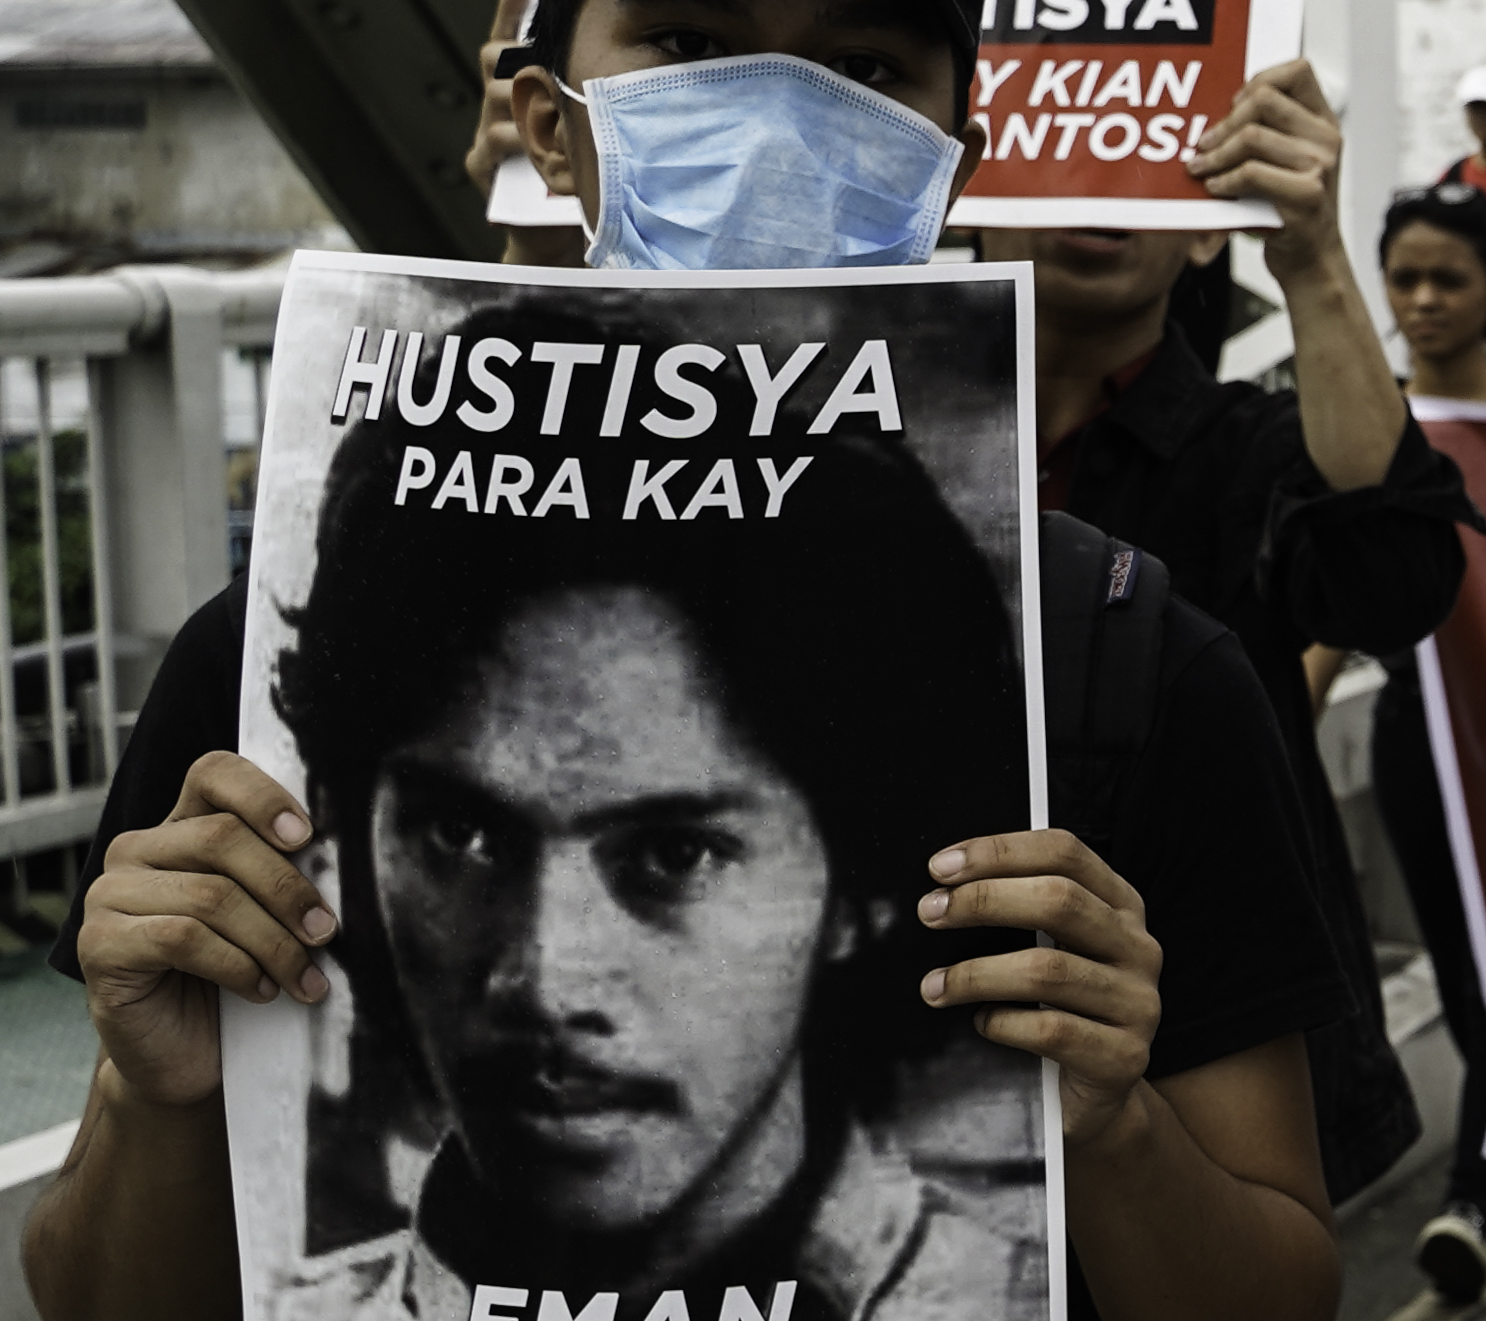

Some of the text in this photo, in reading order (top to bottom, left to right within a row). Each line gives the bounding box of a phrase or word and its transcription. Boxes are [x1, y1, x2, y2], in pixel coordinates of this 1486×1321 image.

[1028, 59, 1203, 108] KIAN
[331, 326, 904, 438] HUSTISYA
[393, 446, 815, 521] PARA KAY
